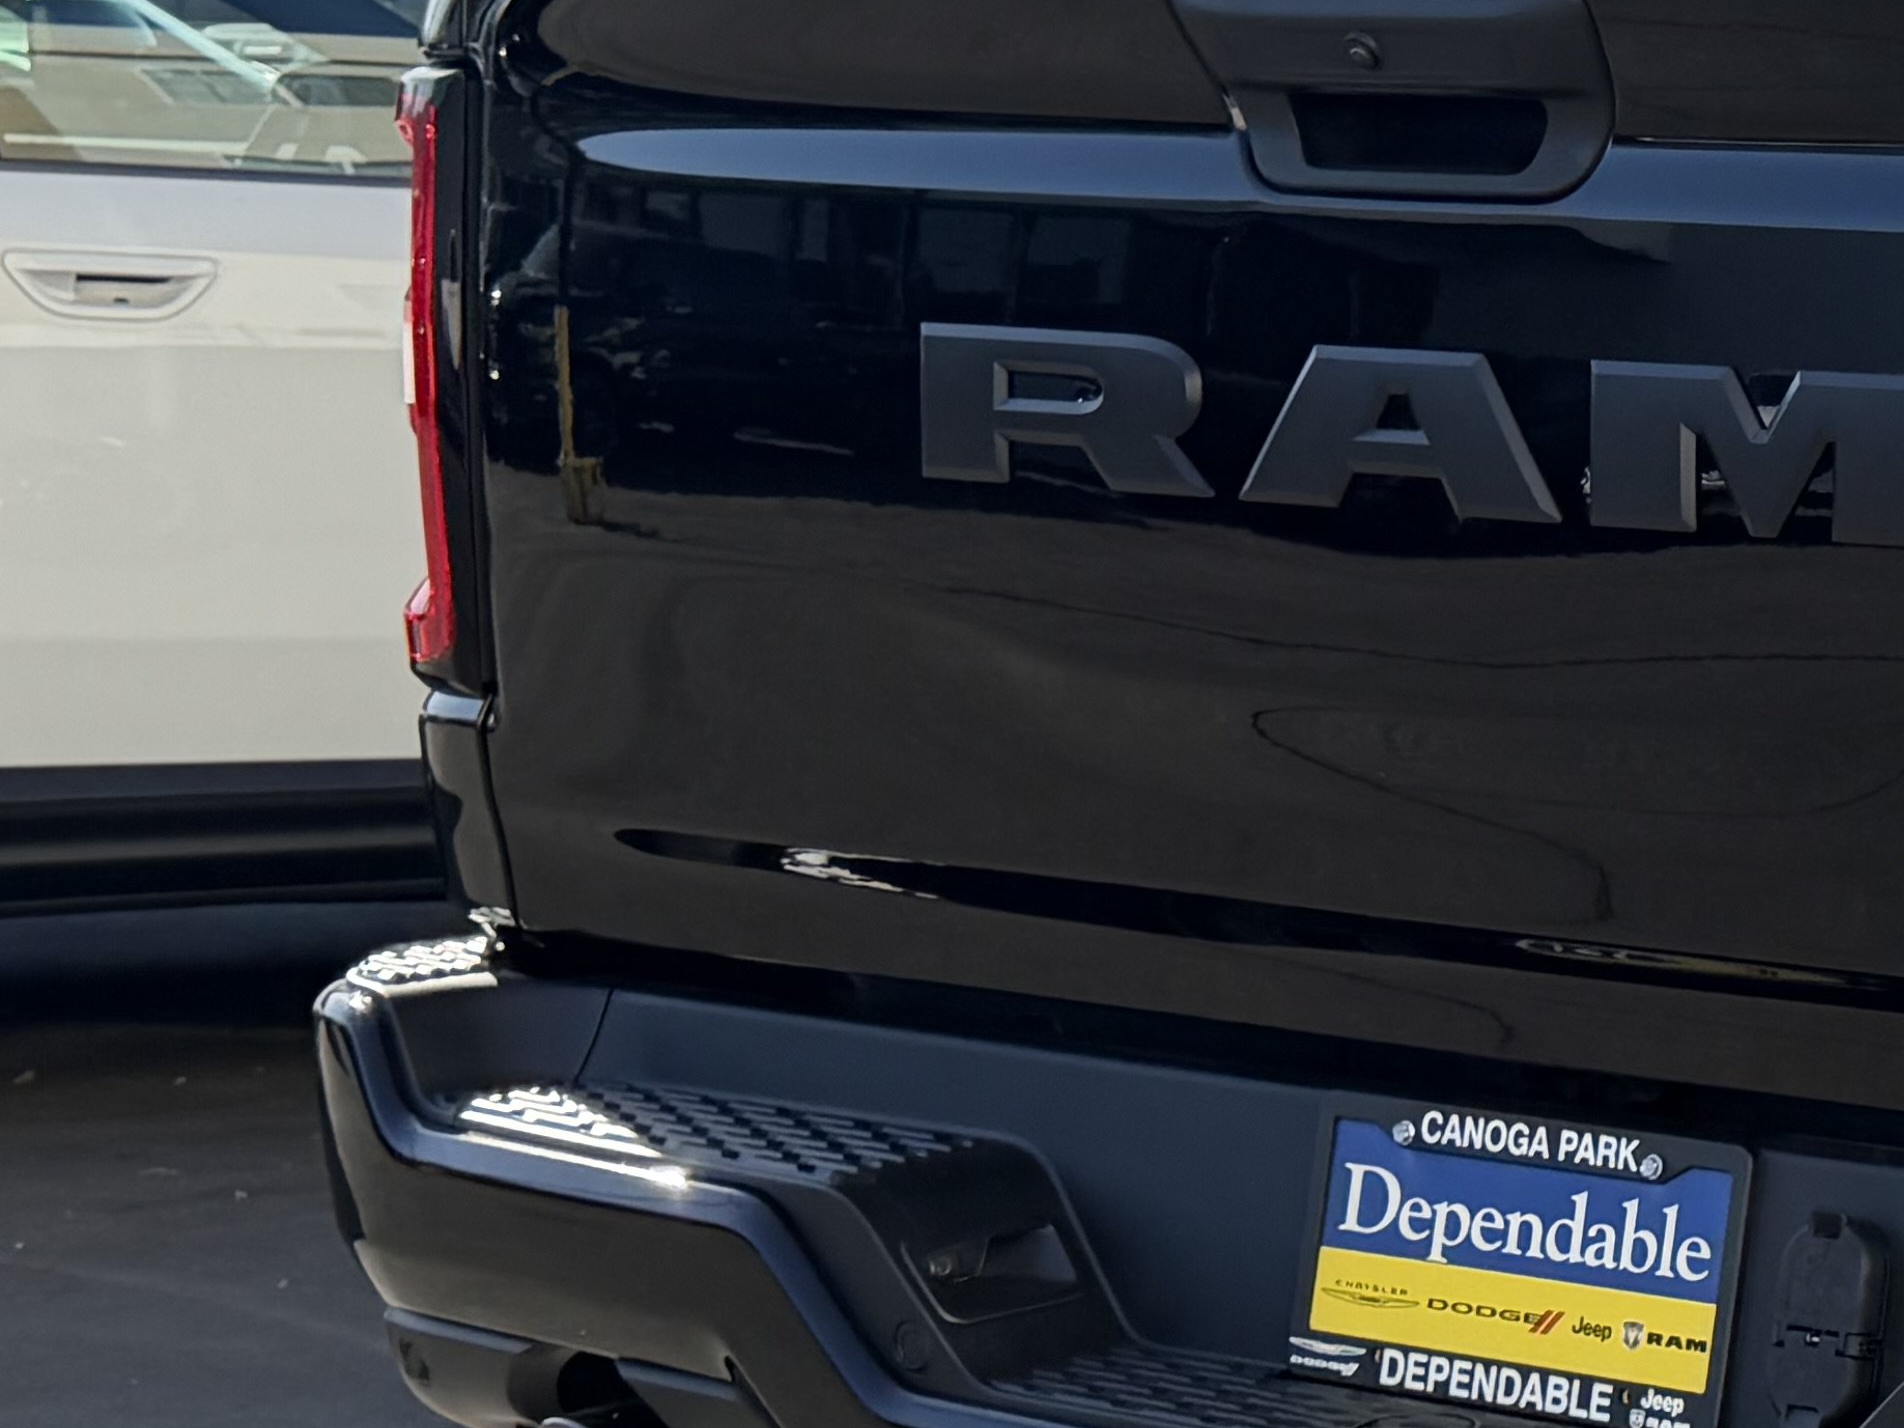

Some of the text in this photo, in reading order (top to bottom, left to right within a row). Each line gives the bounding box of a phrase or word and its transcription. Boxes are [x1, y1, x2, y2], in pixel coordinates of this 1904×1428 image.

[1420, 1109, 1641, 1173] CANOGA PARK
[1337, 1161, 1712, 1282] Dependable
[1334, 1278, 1409, 1296] CHRYSLER
[1426, 1297, 1542, 1325] DODGE
[1571, 1316, 1613, 1343] Jeep
[1646, 1331, 1708, 1353] RAM
[1379, 1347, 1614, 1422] DEPENDABLE
[1640, 1388, 1685, 1417] Jeep
